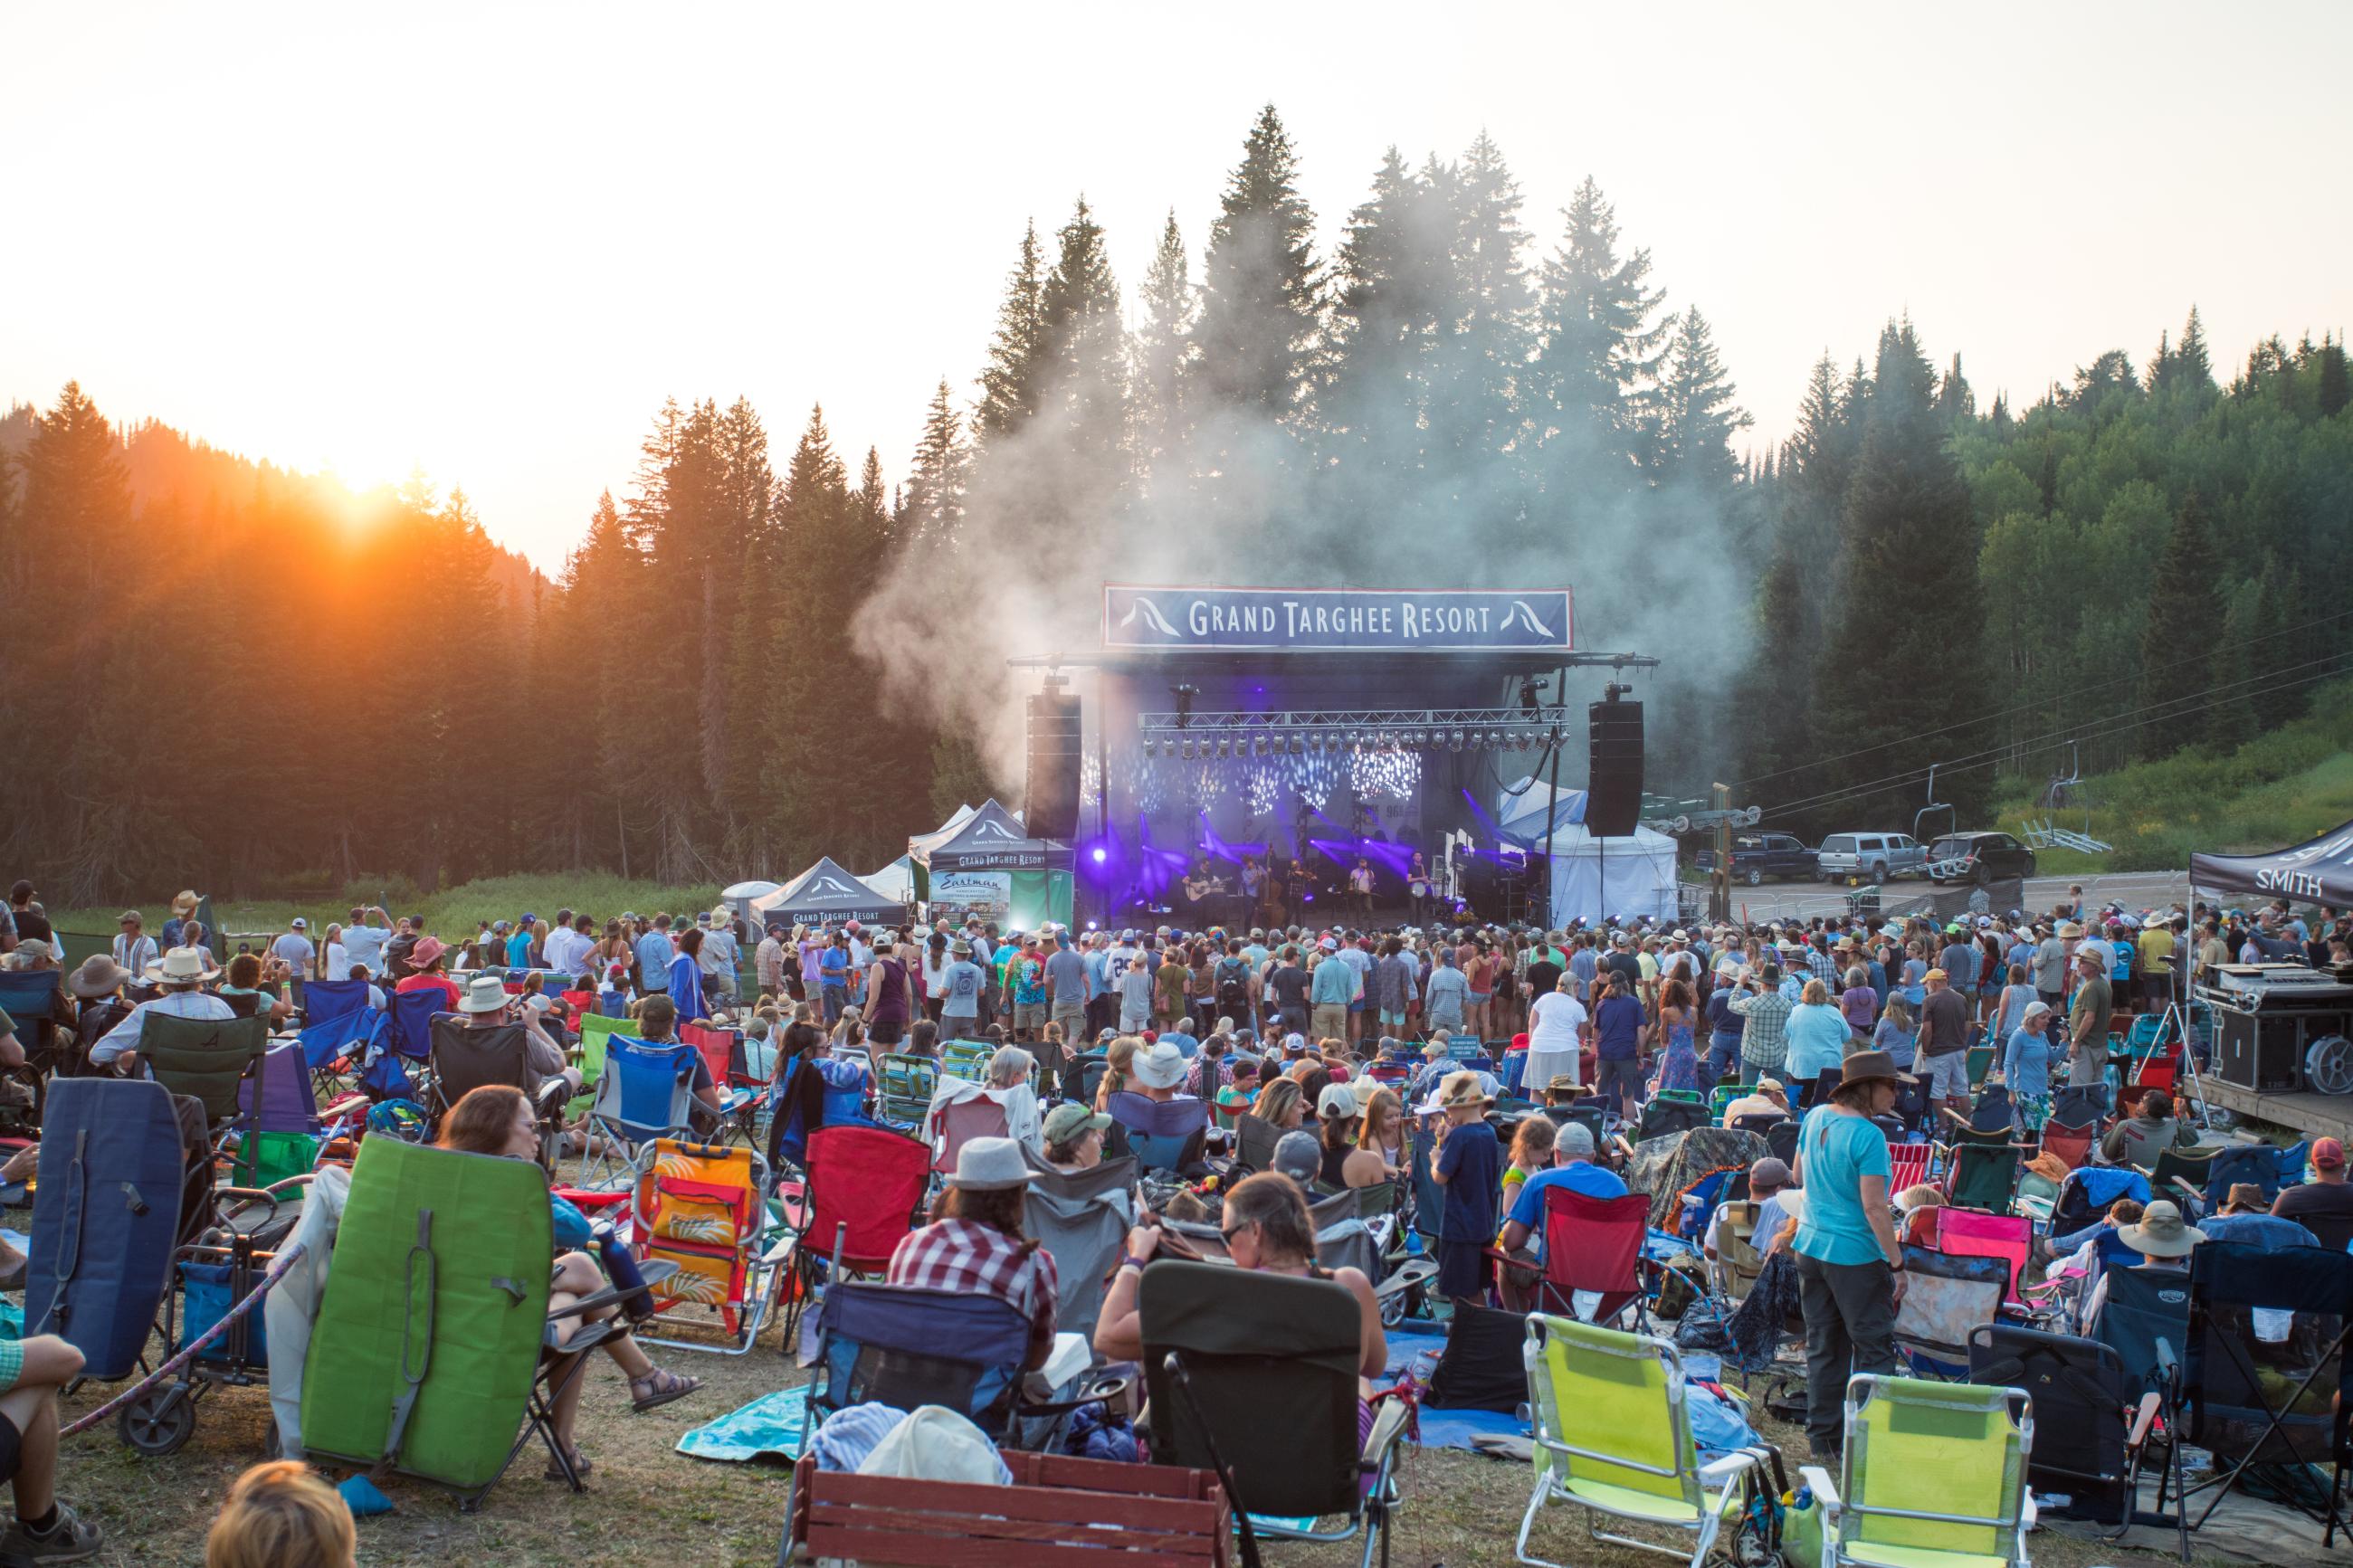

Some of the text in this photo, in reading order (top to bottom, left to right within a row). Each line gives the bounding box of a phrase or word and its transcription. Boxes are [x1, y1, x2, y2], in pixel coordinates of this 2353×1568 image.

[1189, 600, 1491, 639] GRAND TARGHEE RESORT
[959, 856, 985, 867] GRAND
[986, 855, 1018, 866] TARGHEE
[2255, 869, 2324, 898] SMITH
[793, 914, 818, 923] GRAND
